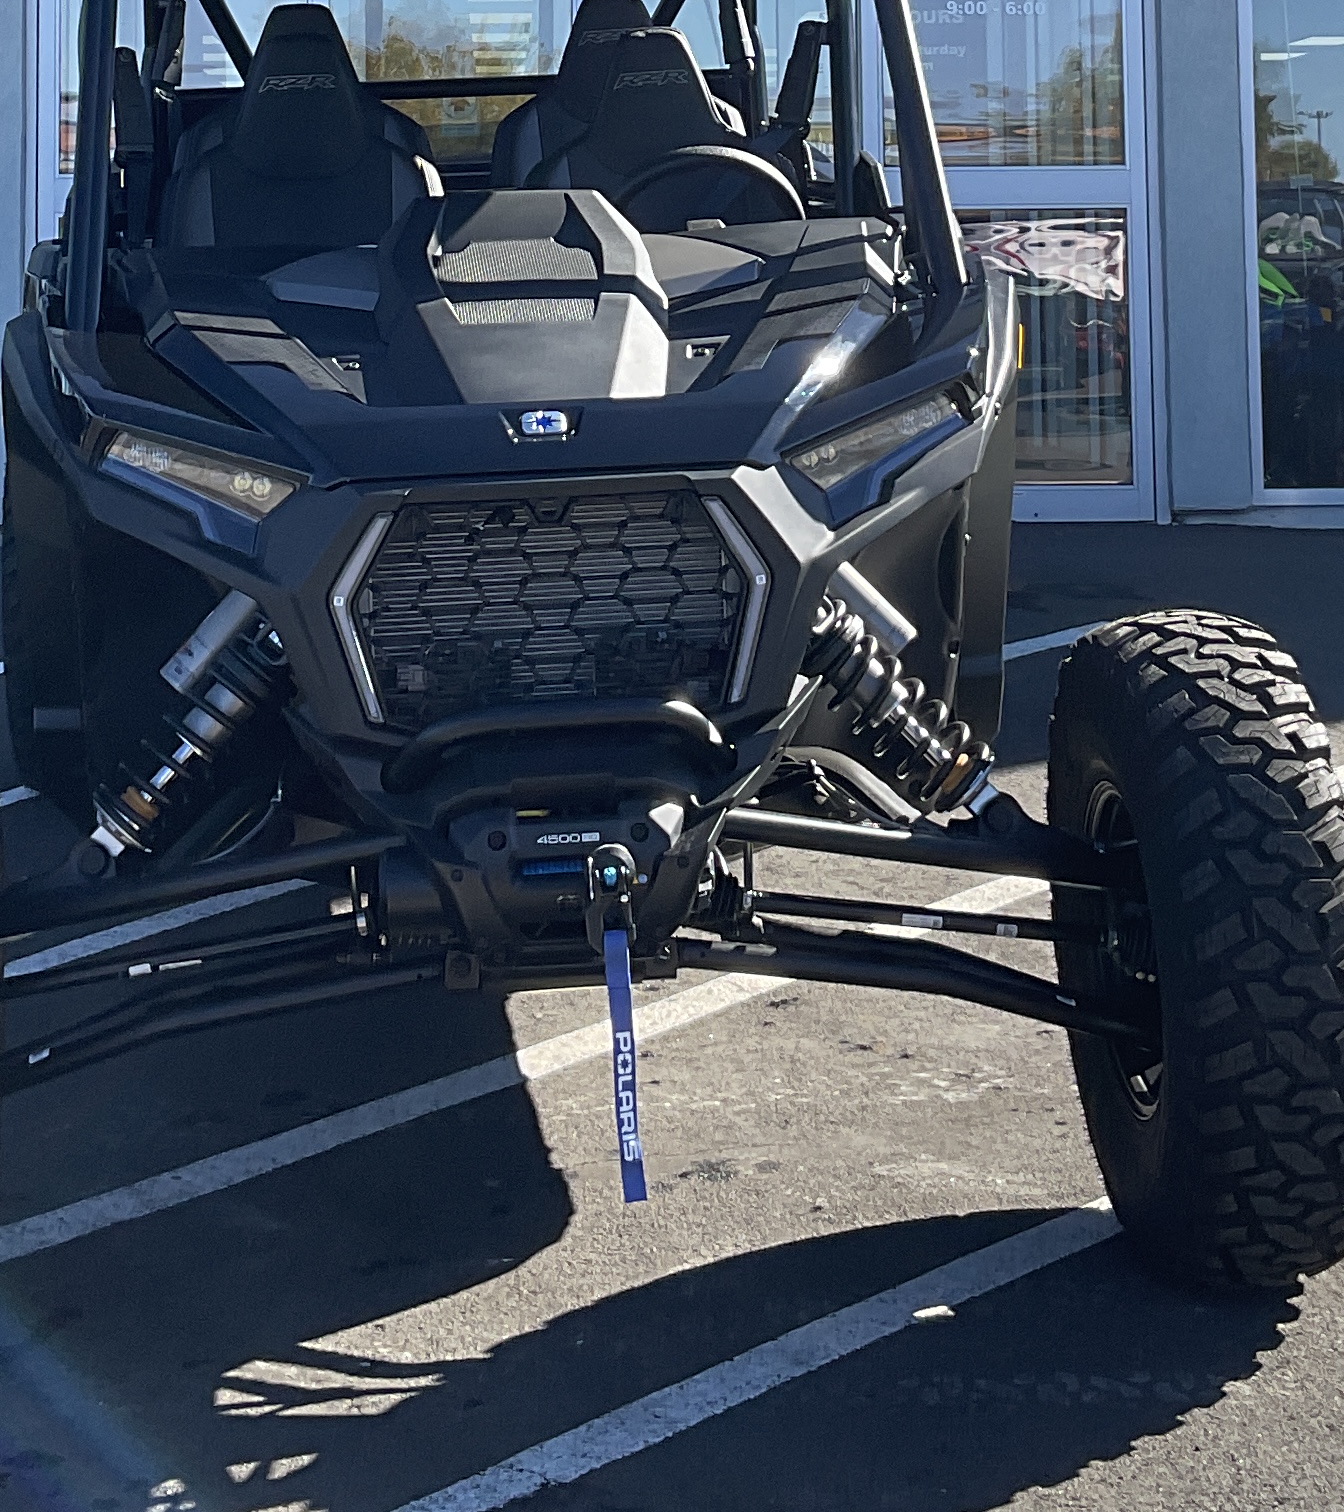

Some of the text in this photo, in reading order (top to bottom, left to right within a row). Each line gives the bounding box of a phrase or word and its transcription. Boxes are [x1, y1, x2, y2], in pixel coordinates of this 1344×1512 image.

[946, 1, 987, 15] 9:00
[1005, 2, 1046, 15] 6:00
[911, 10, 964, 24] OURS
[258, 74, 336, 93] RZR
[613, 69, 689, 89] RZR
[537, 833, 581, 844] 4500
[616, 1030, 641, 1162] POLARIS
